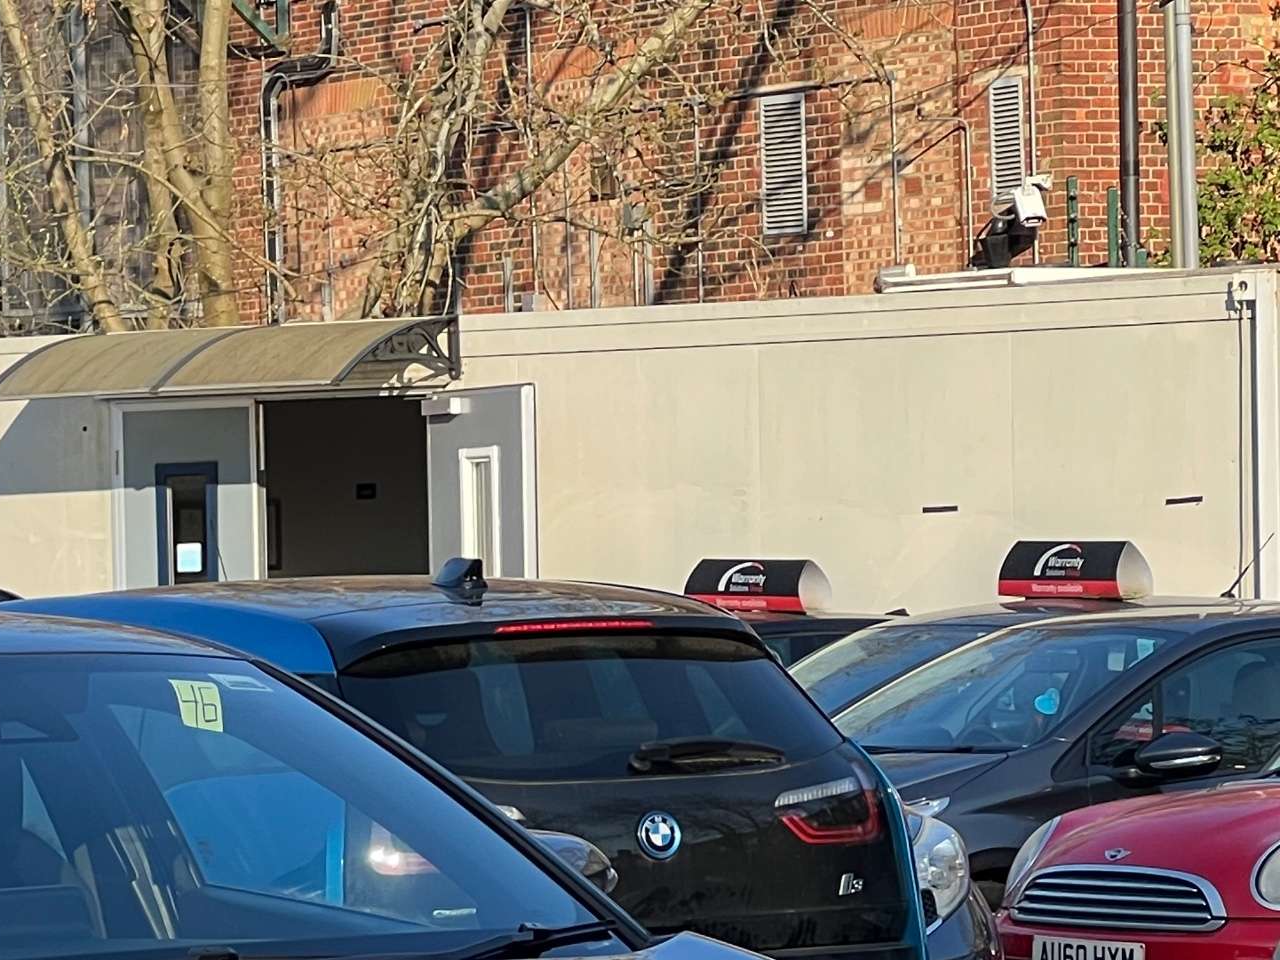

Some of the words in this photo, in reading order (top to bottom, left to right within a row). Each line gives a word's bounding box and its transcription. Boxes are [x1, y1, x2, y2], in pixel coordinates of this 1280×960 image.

[1048, 557, 1085, 570] Warranty
[731, 573, 766, 586] Warranty
[177, 684, 218, 728] 46
